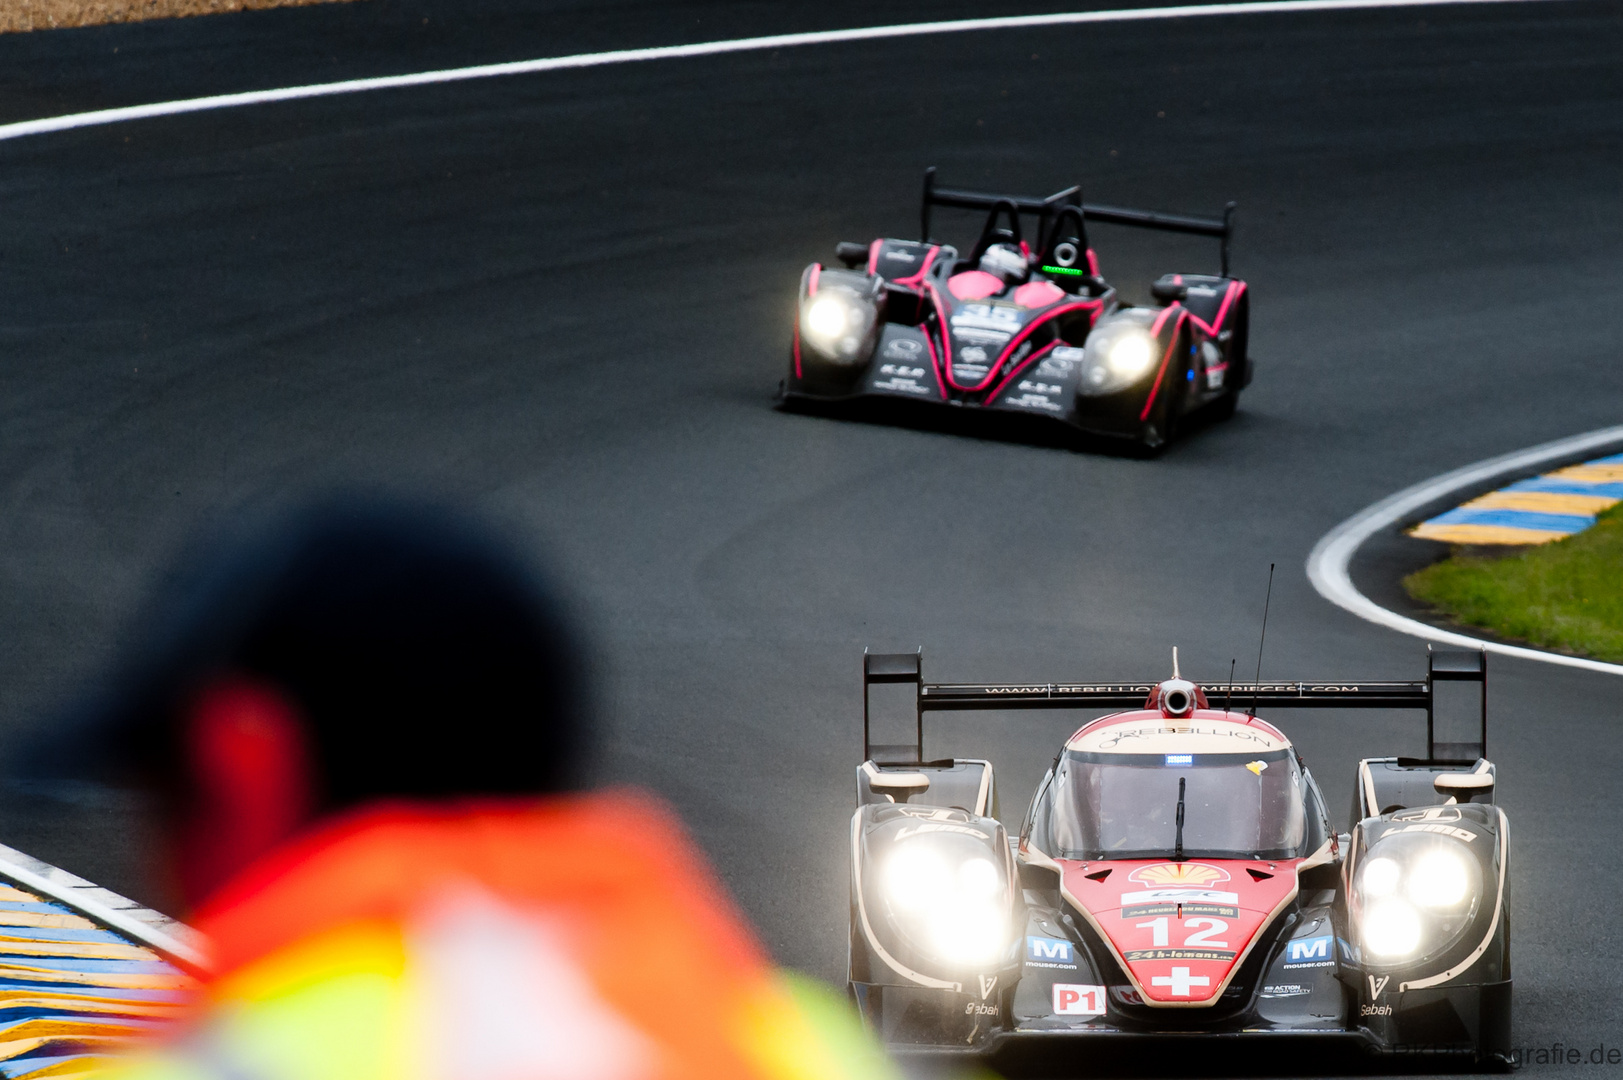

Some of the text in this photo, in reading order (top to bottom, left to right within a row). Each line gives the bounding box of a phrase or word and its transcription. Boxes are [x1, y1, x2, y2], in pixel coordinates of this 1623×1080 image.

[1135, 917, 1229, 948] 12
[1127, 951, 1155, 960] 24
[1025, 961, 1078, 970] mouser.com
[1283, 960, 1335, 970] mouser.com
[1059, 990, 1096, 1011] P1
[1360, 1003, 1393, 1016] Sebah
